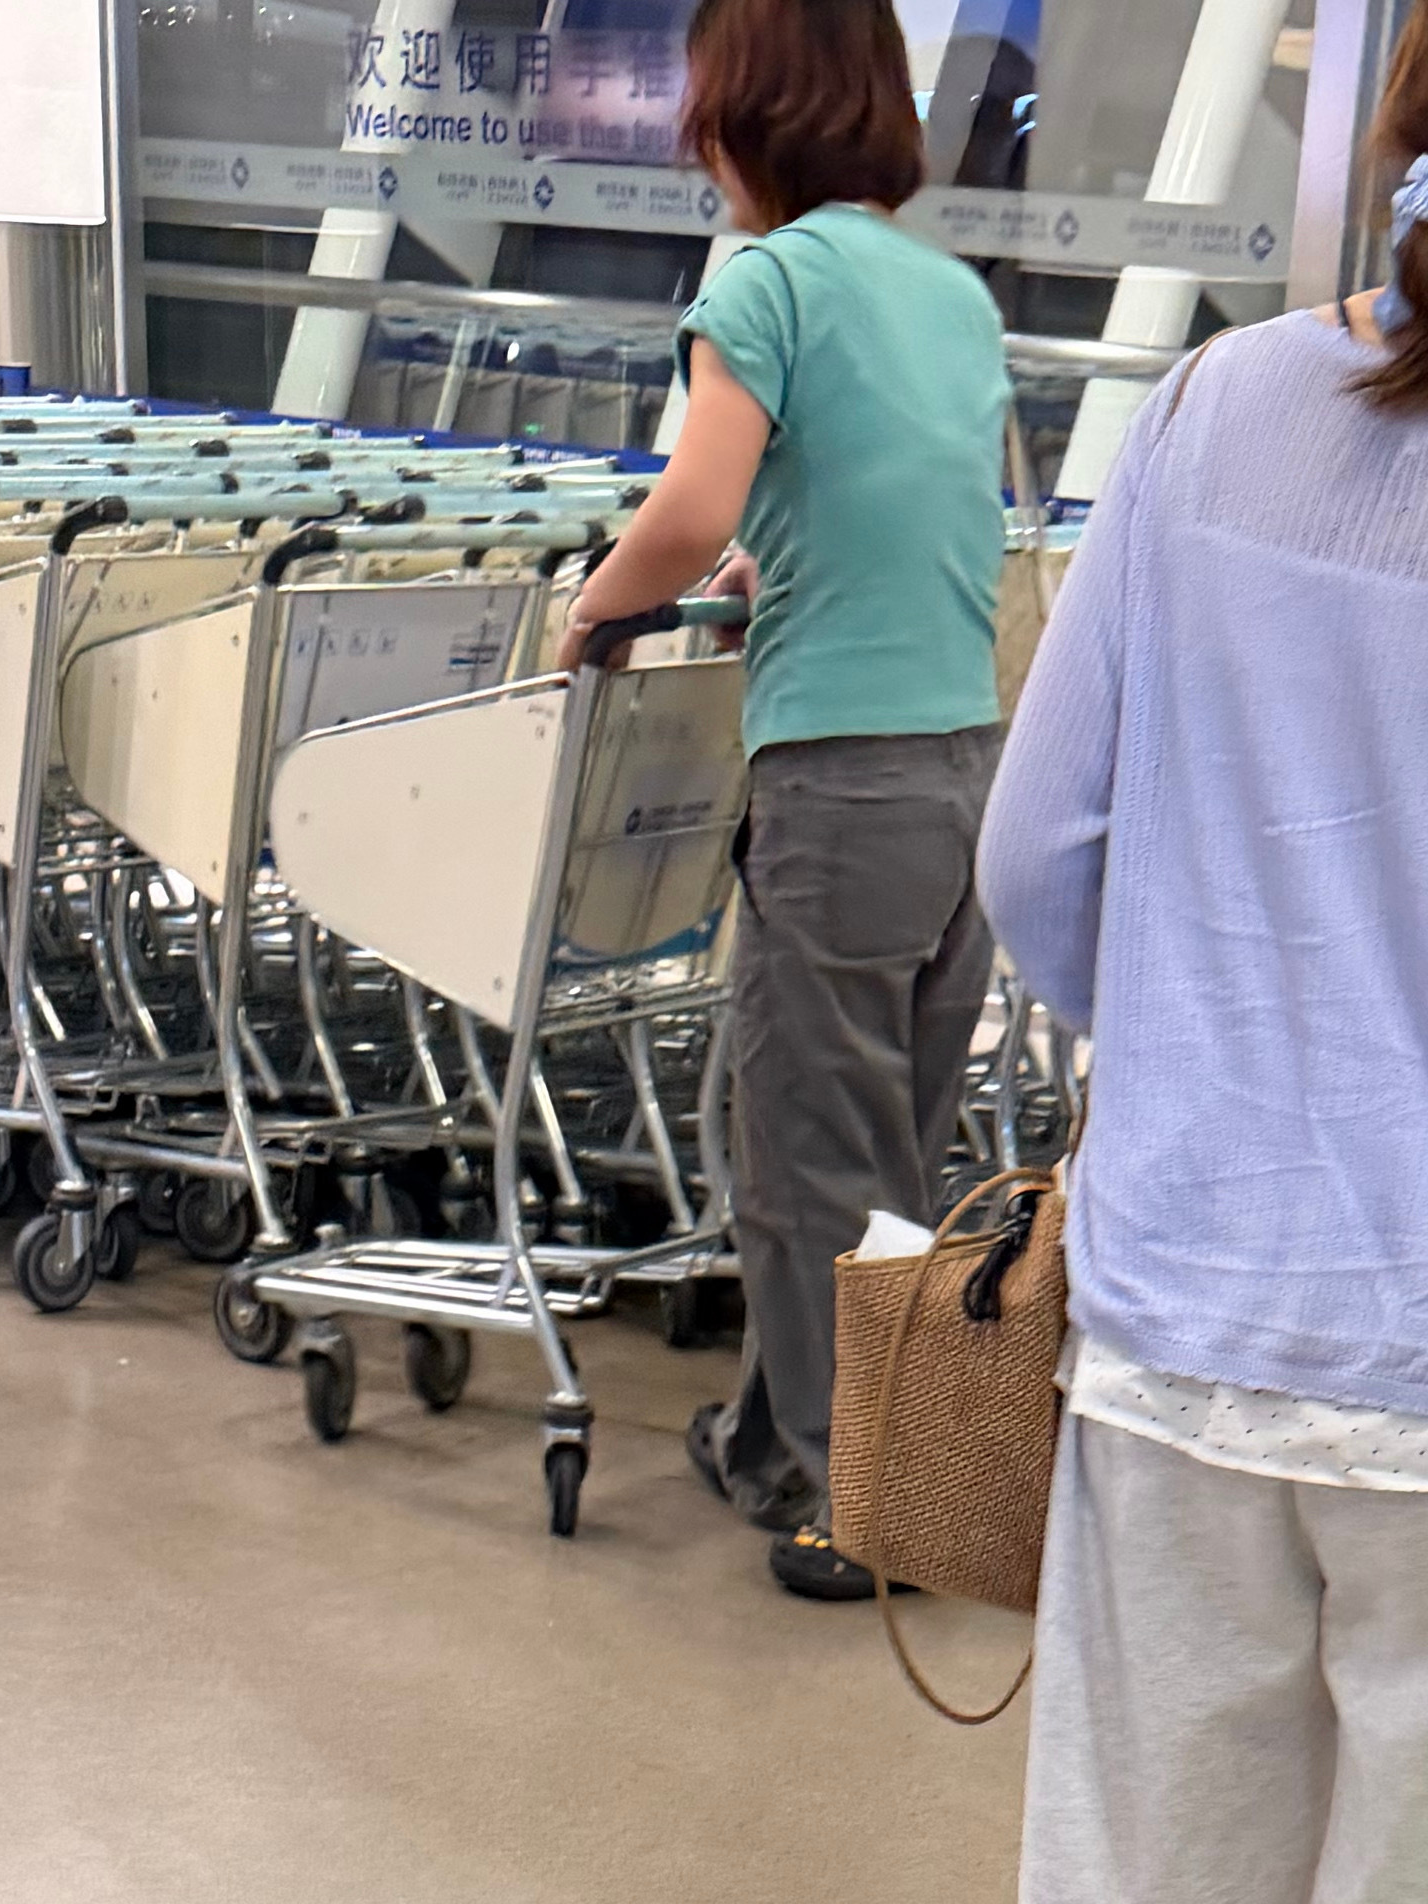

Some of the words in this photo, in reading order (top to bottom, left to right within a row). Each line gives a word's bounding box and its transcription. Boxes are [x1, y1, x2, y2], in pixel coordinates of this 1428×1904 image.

[346, 103, 471, 143] Welcome
[482, 110, 508, 144] to
[519, 118, 570, 147] use
